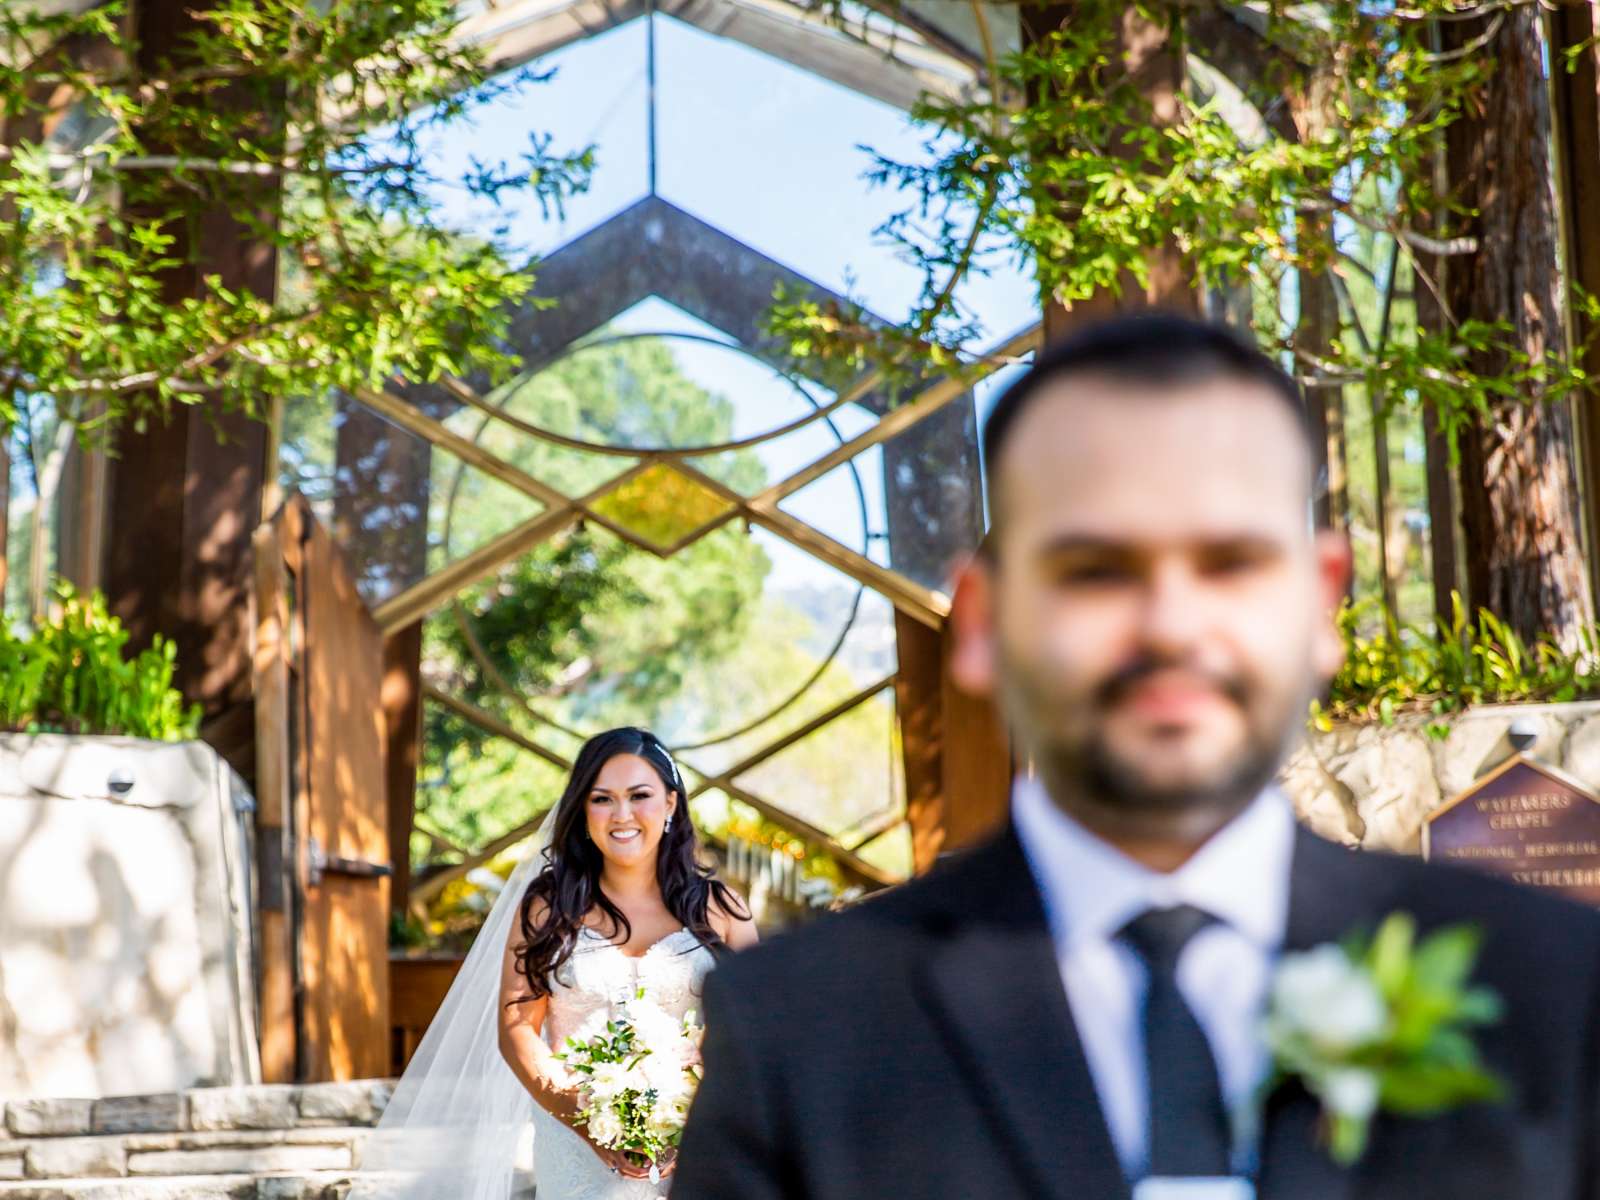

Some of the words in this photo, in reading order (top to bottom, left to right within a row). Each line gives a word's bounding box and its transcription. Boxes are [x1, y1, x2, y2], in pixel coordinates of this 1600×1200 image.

[1489, 813, 1551, 830] CHAPEL
[1446, 845, 1516, 858] NATIONAL
[1525, 840, 1599, 856] MEMORIAL
